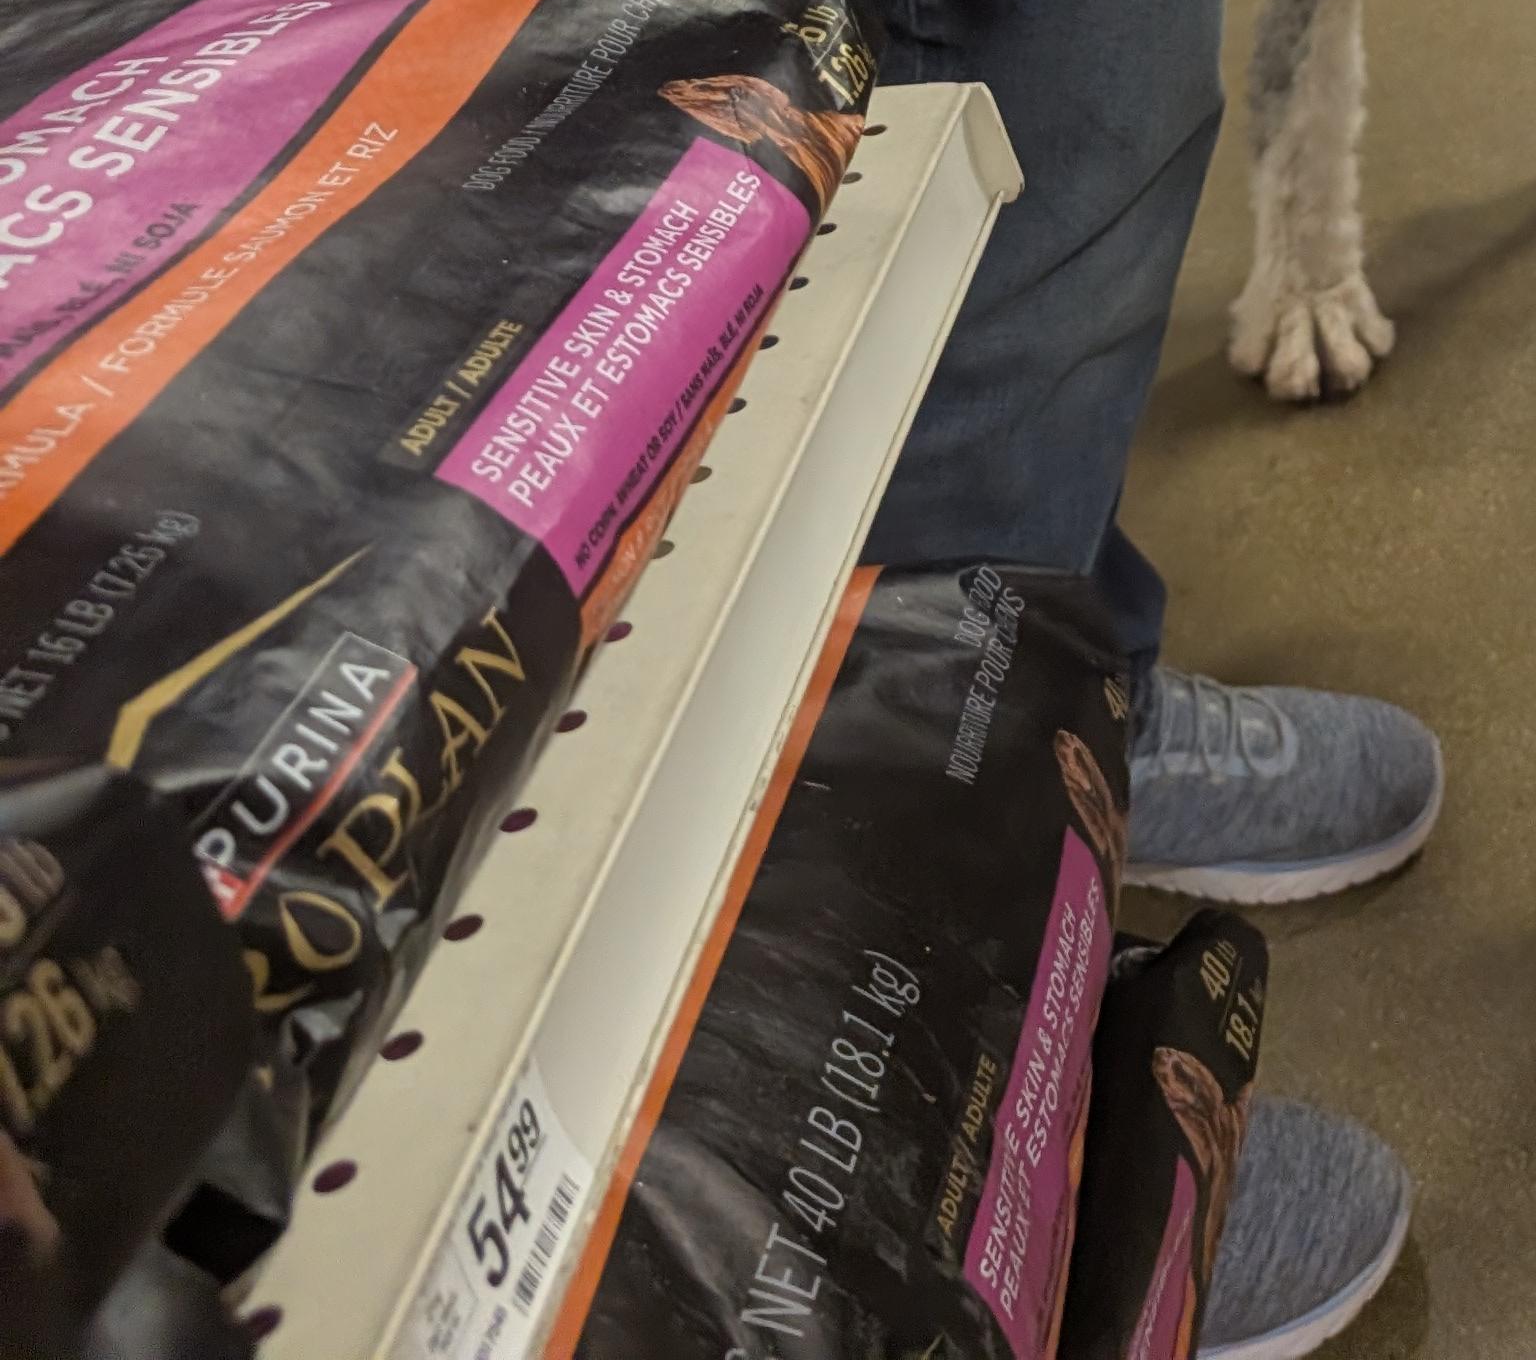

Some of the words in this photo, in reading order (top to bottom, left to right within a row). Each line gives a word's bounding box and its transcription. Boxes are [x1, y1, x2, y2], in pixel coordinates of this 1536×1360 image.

[69, 0, 332, 178] SENSIBLES
[462, 164, 512, 191] DOG
[590, 18, 642, 64] POUR
[99, 266, 240, 373] FORMULE
[222, 186, 335, 264] SAUMON
[319, 160, 360, 188] ET
[346, 121, 399, 161] RIZ
[617, 198, 700, 289] STOMACH
[507, 412, 589, 509] PEAUX
[570, 375, 611, 420] ET
[595, 266, 693, 386] ESTOMACS
[677, 168, 762, 273] SENSIBLES
[564, 302, 622, 359] SKIN
[603, 287, 634, 306] &
[400, 393, 459, 456] ADULT
[456, 318, 525, 388] ADULTE
[471, 355, 581, 483] SENSITIVE
[55, 598, 115, 636] LB
[953, 606, 990, 649] DOG
[974, 636, 1014, 694] POUR
[193, 661, 391, 868] PURINA
[851, 949, 921, 1017] kg)
[1042, 901, 1078, 1032] STOMACH
[1199, 948, 1231, 1002] 40
[820, 1009, 895, 1114] (18.1
[1026, 1008, 1075, 1169] ESTOMACS
[1068, 875, 1101, 1013] SENSIBLES
[1038, 1026, 1053, 1056] &
[1225, 991, 1260, 1062] 18.1
[1016, 1048, 1047, 1129] SKIN
[799, 1104, 864, 1174] LB
[934, 1157, 971, 1240] ADULT
[961, 1052, 1000, 1146] ADULTE
[782, 1165, 847, 1233] 40
[978, 1121, 1021, 1291] SENSITIVE
[740, 1222, 828, 1337] NET
